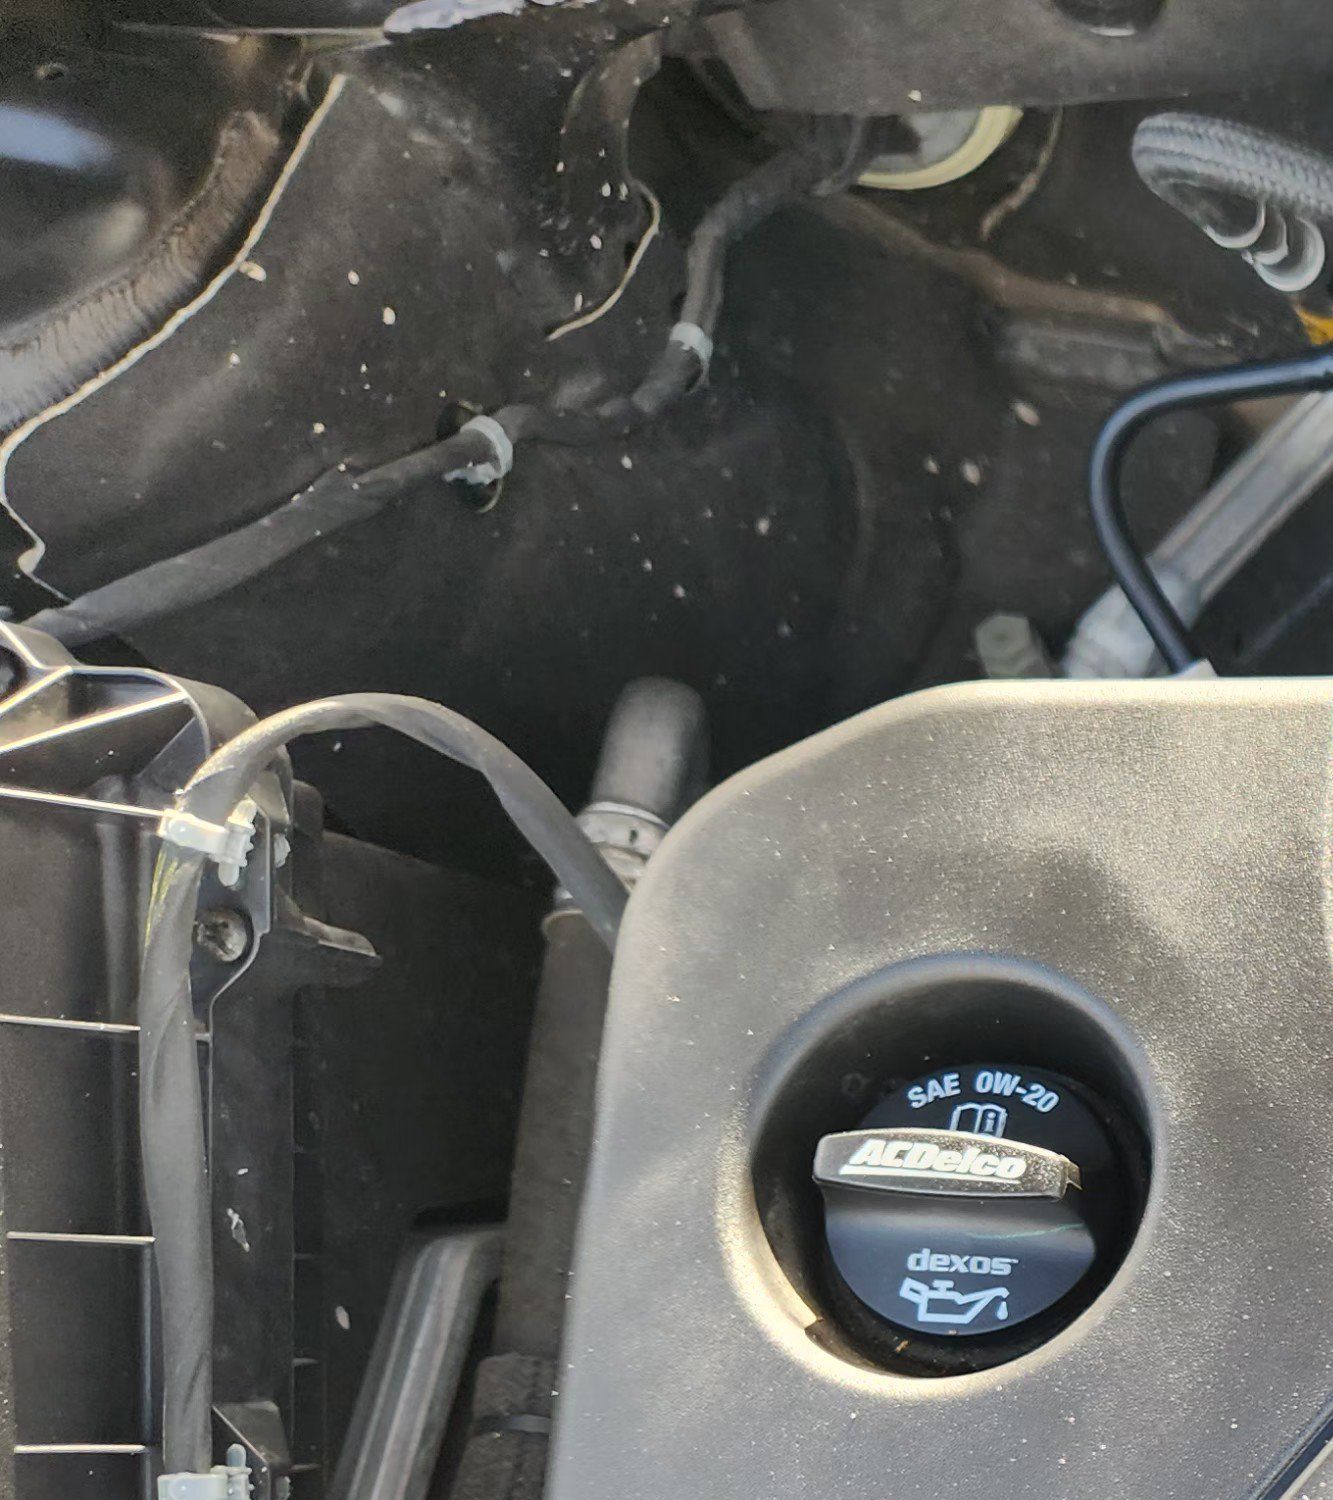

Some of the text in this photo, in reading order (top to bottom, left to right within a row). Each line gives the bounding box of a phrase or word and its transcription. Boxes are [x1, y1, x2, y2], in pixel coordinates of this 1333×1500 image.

[907, 1070, 1061, 1114] SAE 0W-20
[848, 1138, 1028, 1180] ACDelco
[906, 1248, 1012, 1276] dexos
